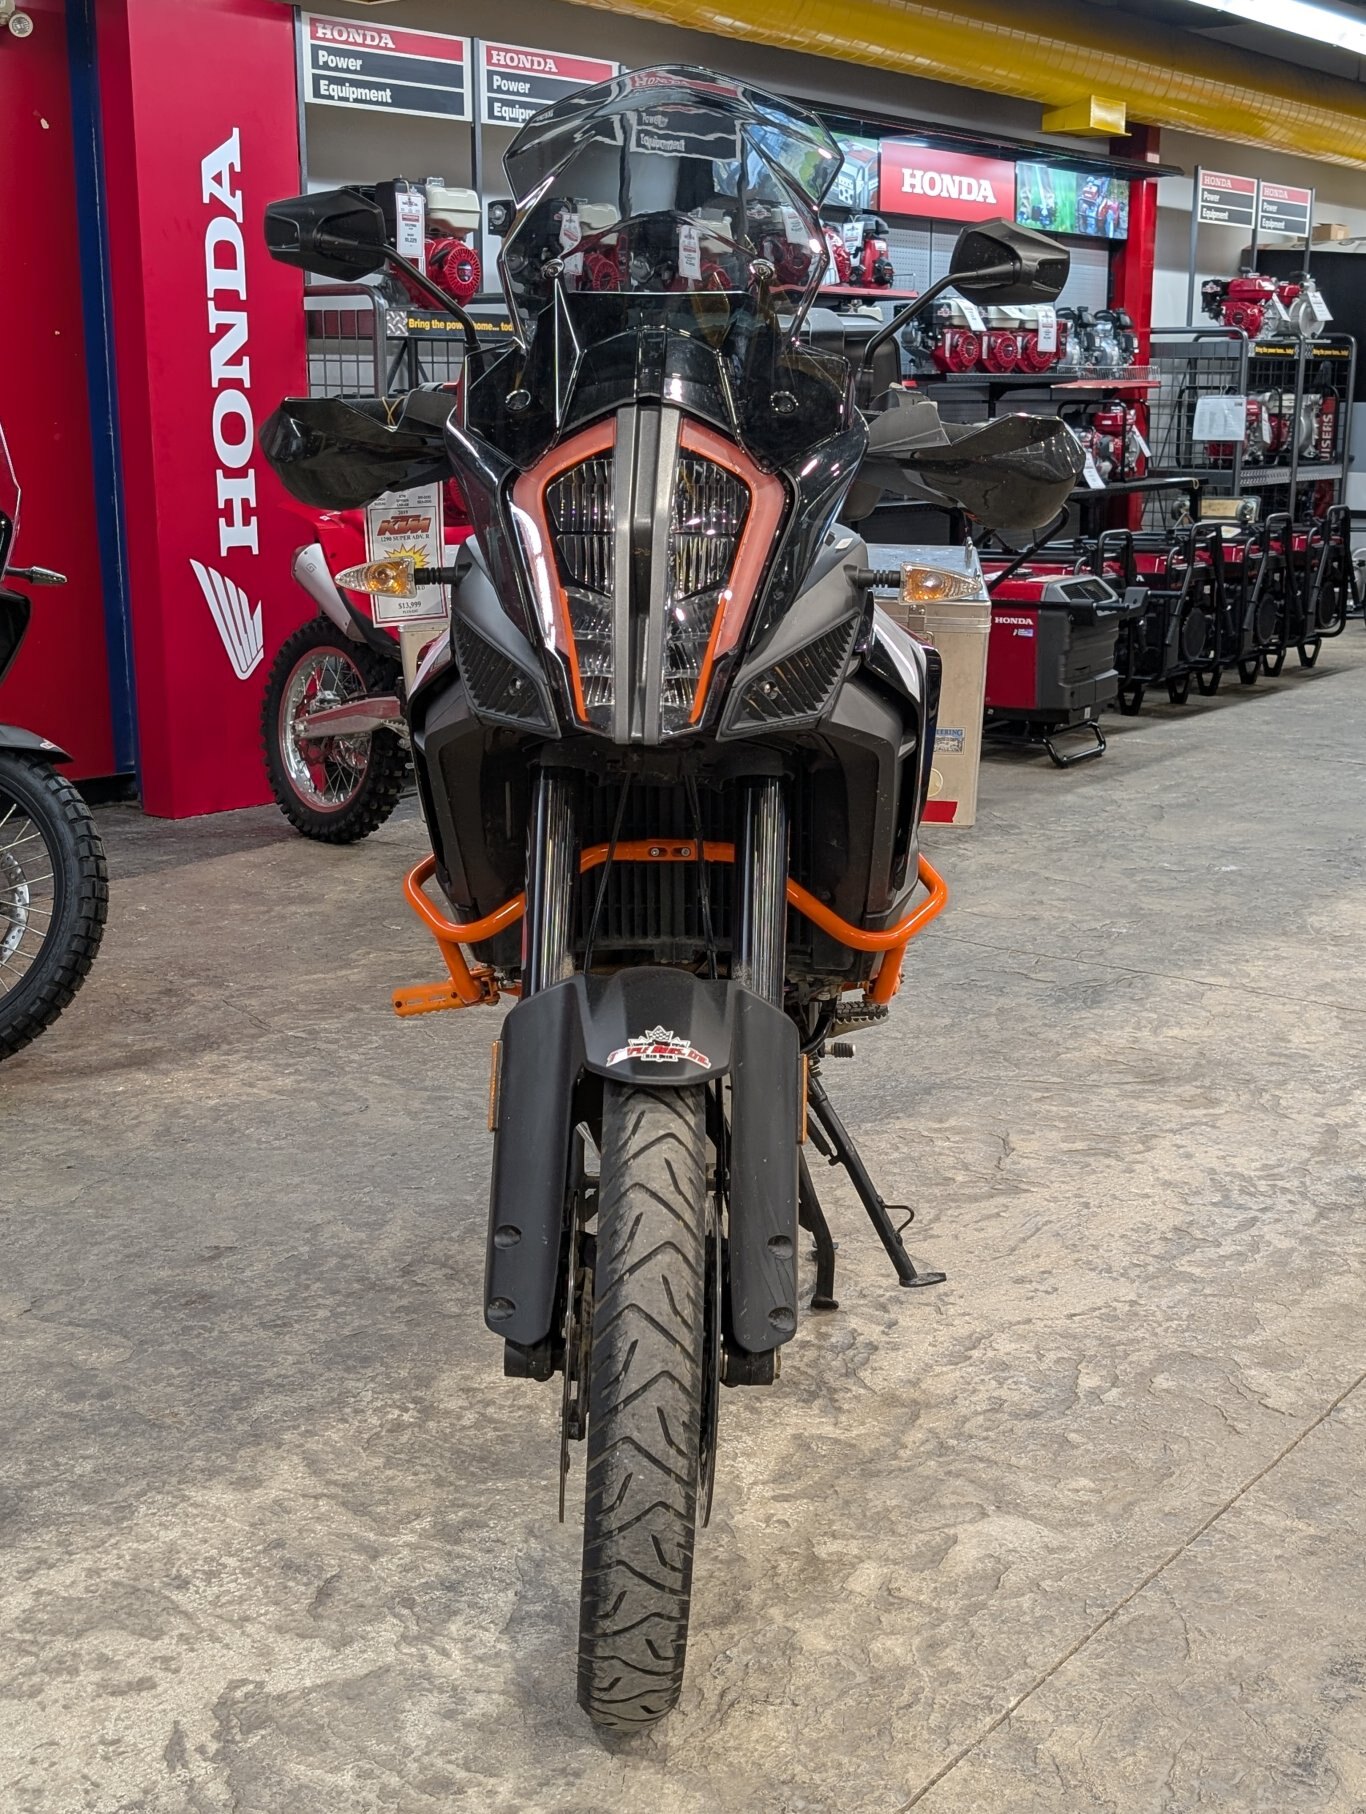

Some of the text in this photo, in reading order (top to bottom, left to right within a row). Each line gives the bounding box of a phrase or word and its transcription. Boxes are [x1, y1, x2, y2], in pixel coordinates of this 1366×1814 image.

[315, 22, 396, 49] HONDA
[318, 50, 362, 71] Power
[491, 50, 558, 72] HONDA
[319, 79, 392, 103] Equipment
[493, 76, 530, 94] Power
[901, 168, 997, 204] HONDA
[1203, 175, 1233, 189] HONDA
[1203, 191, 1220, 203] Power
[1263, 187, 1288, 199] HONDA
[1202, 207, 1229, 220] Equipment
[1262, 201, 1278, 212] Power
[1261, 218, 1285, 230] Equipment
[408, 318, 430, 330] Bring
[431, 319, 445, 329] the
[446, 321, 465, 331] pow
[201, 127, 259, 557] HONDA
[377, 515, 432, 536] KTM
[398, 601, 422, 609] $13,999
[995, 616, 1034, 625] HONDA
